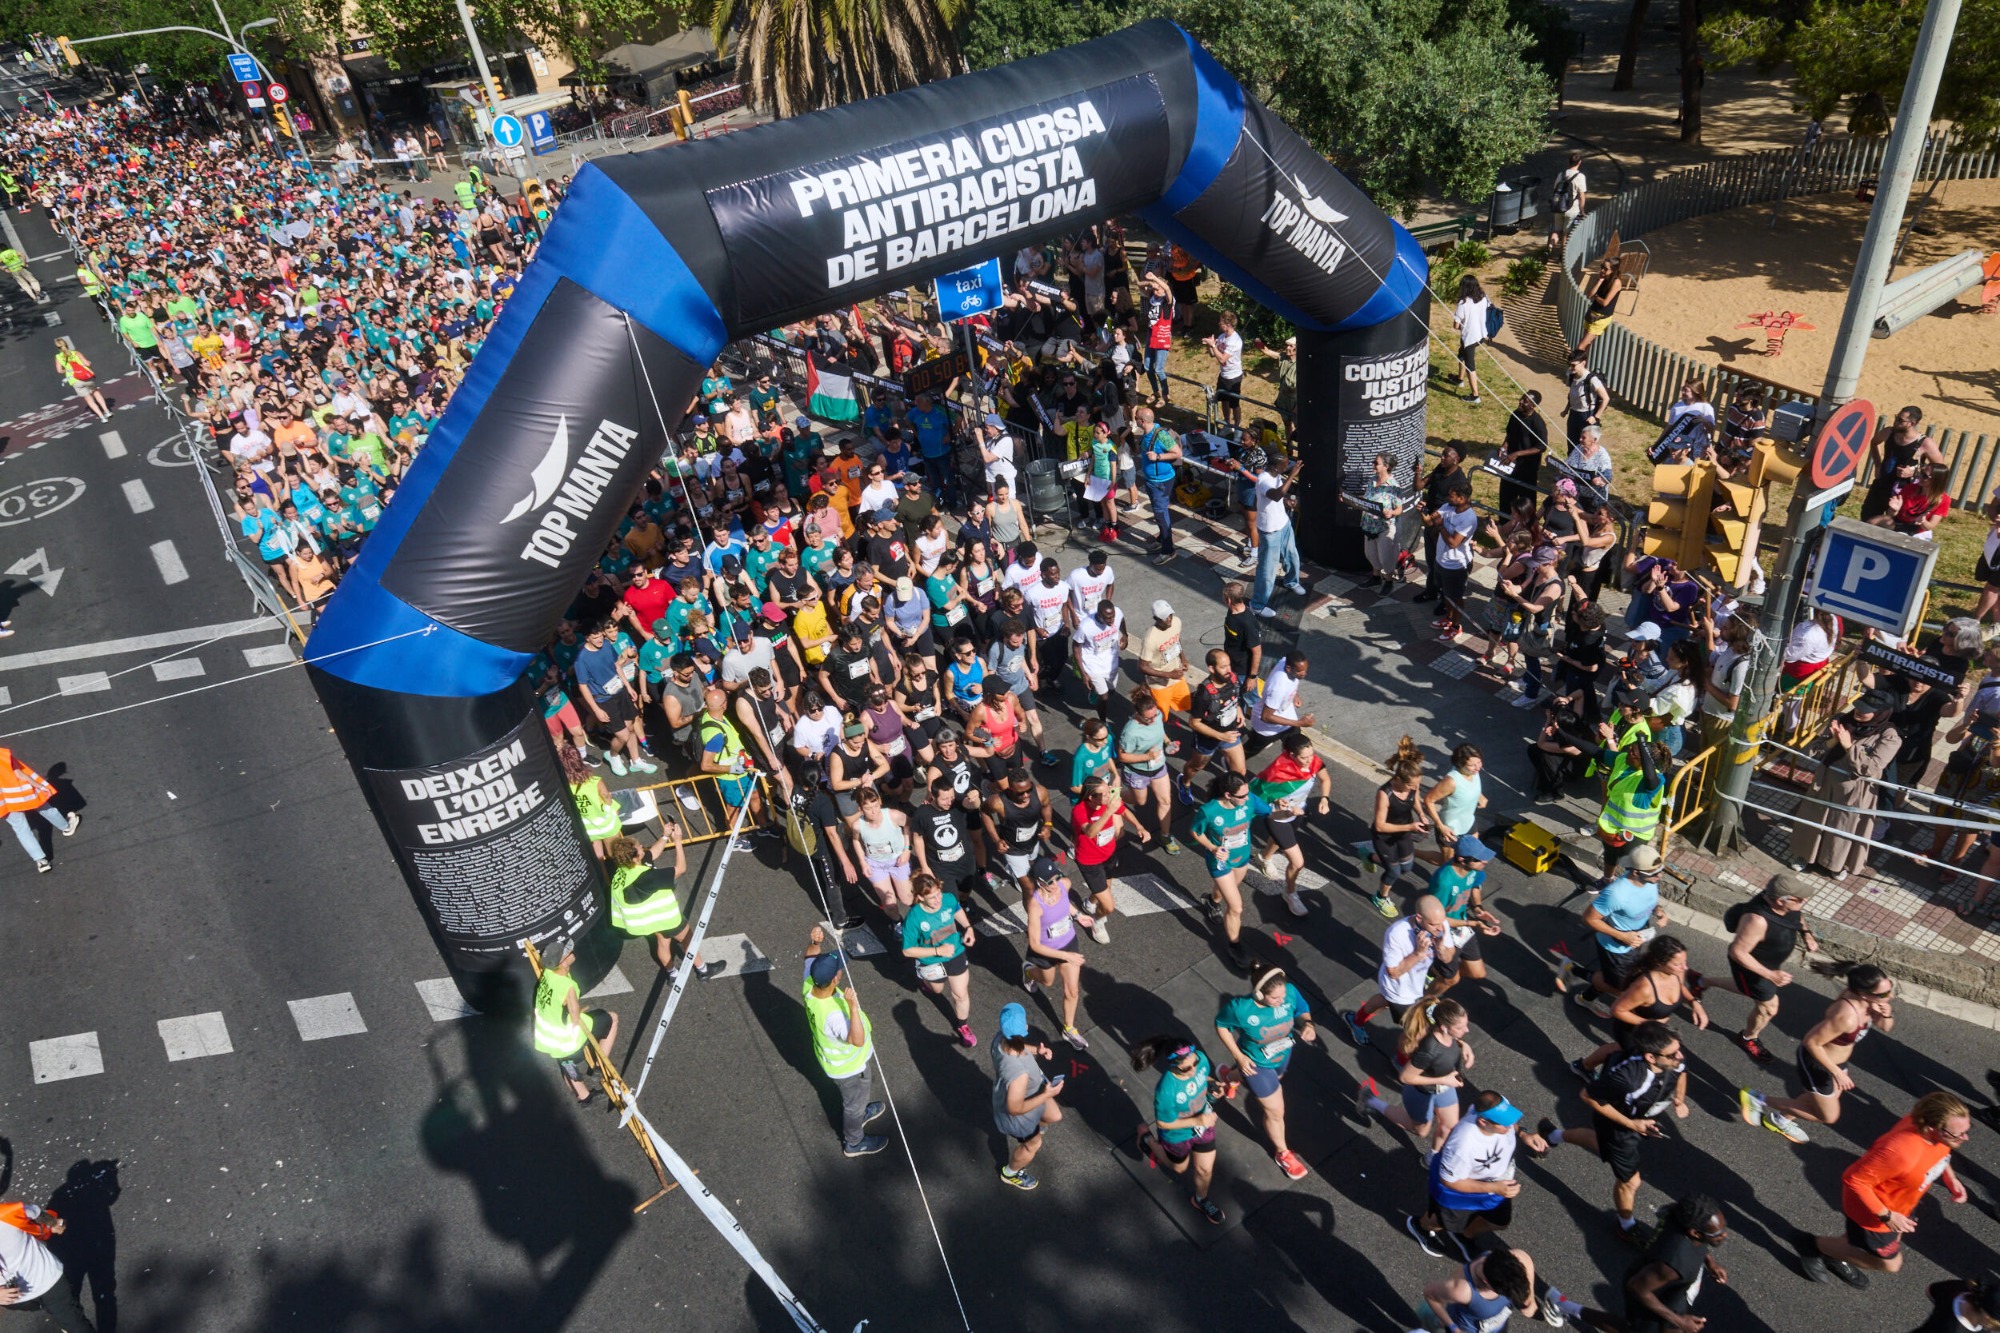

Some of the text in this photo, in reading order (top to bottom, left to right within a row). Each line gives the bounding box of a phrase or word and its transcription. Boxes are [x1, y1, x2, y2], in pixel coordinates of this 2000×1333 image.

[272, 89, 284, 97] 30
[531, 113, 545, 137] P
[789, 100, 1106, 218] PRIMERA CURSA
[843, 146, 1084, 250] ANTIRACISTA
[826, 178, 1096, 289] DE BARCELONA
[1260, 190, 1346, 275] TOP MANTA
[955, 275, 983, 293] taxi
[912, 370, 930, 392] 00
[1369, 381, 1427, 416] SOCIAL
[1651, 415, 1693, 459] ANTIRACISTA
[520, 418, 639, 569] TOP MANTA
[1841, 544, 1890, 594] P
[1866, 644, 1955, 686] ANTIRACISTA
[400, 738, 527, 801] DEIXEM
[417, 781, 545, 844] ENRERE
[433, 773, 518, 820] L'ODI
